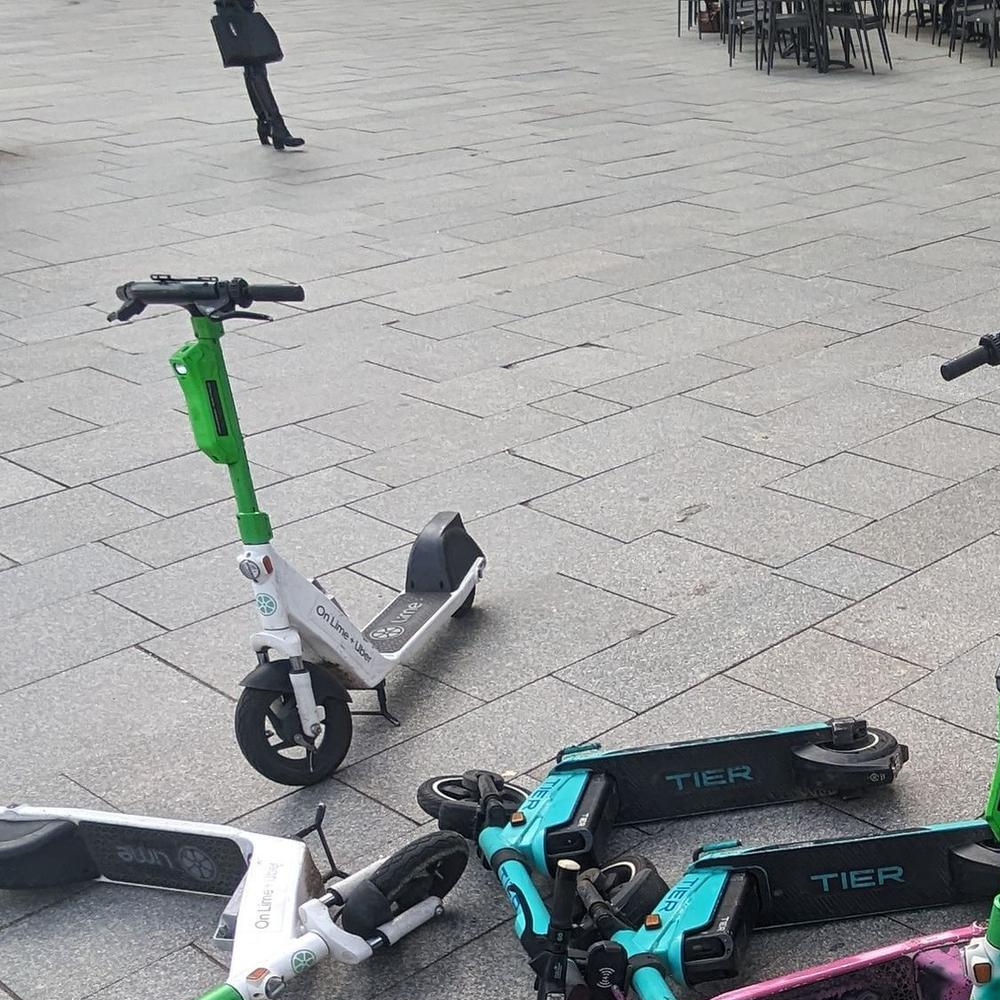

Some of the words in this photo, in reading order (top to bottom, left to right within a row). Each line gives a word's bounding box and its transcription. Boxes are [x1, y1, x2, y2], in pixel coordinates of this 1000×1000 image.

[391, 601, 423, 623] Lime
[316, 605, 331, 622] On
[330, 616, 349, 640] Lime
[354, 642, 372, 663] Uber
[665, 765, 754, 791] TIER
[520, 778, 563, 810] TIER
[116, 845, 175, 869] Lime
[810, 866, 905, 892] TIER
[257, 889, 274, 912] Lime
[659, 877, 699, 912] TIER
[254, 914, 270, 929] On
